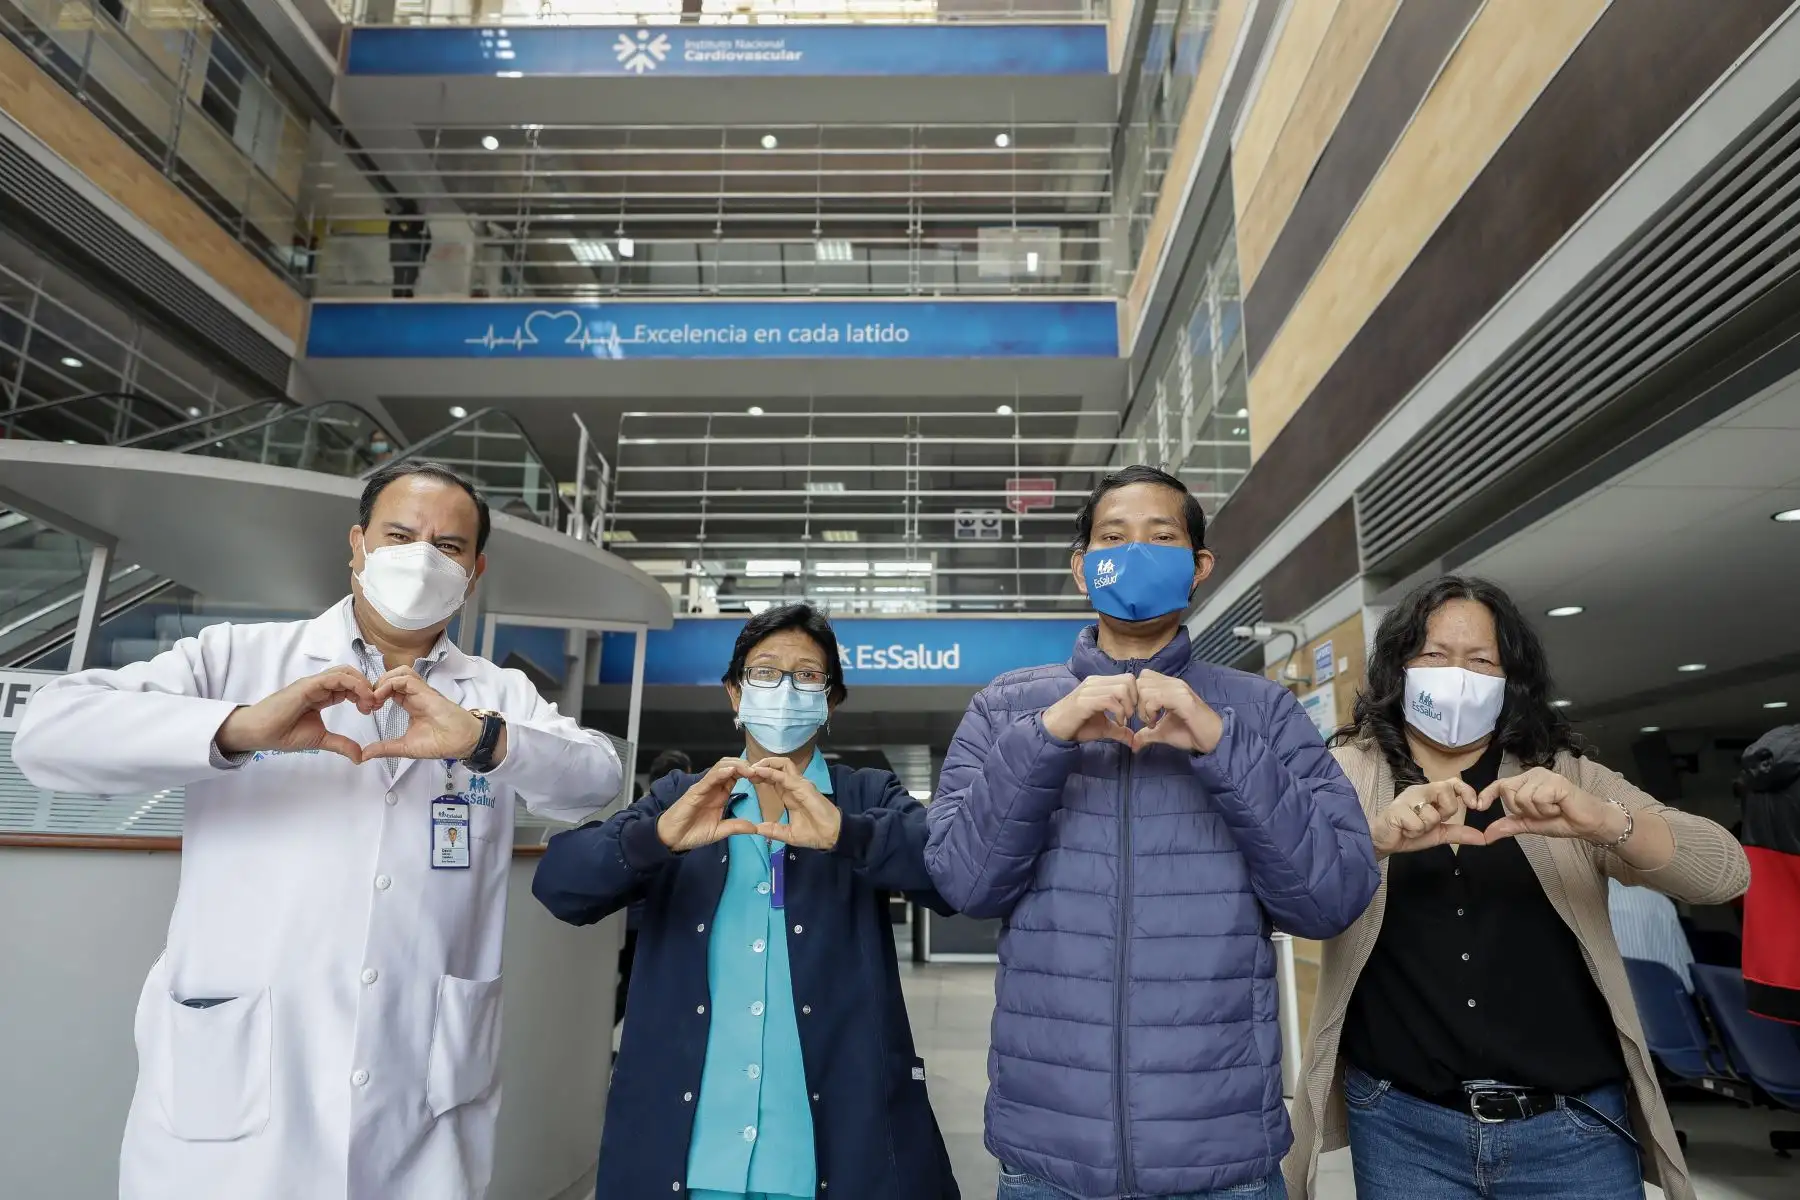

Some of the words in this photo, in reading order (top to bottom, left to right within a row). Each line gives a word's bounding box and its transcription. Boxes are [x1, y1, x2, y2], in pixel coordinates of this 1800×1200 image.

[684, 38, 732, 50] Instituto
[734, 38, 785, 50] Nacional
[684, 49, 804, 62] Cardiovascular
[634, 324, 748, 343] Excelencia
[753, 327, 782, 343] en
[787, 323, 840, 343] cada
[846, 323, 909, 343] latido
[1093, 572, 1119, 589] EsSalud
[856, 642, 960, 670] EsSalud
[0, 682, 32, 718] F
[1411, 700, 1442, 721] EsSalud
